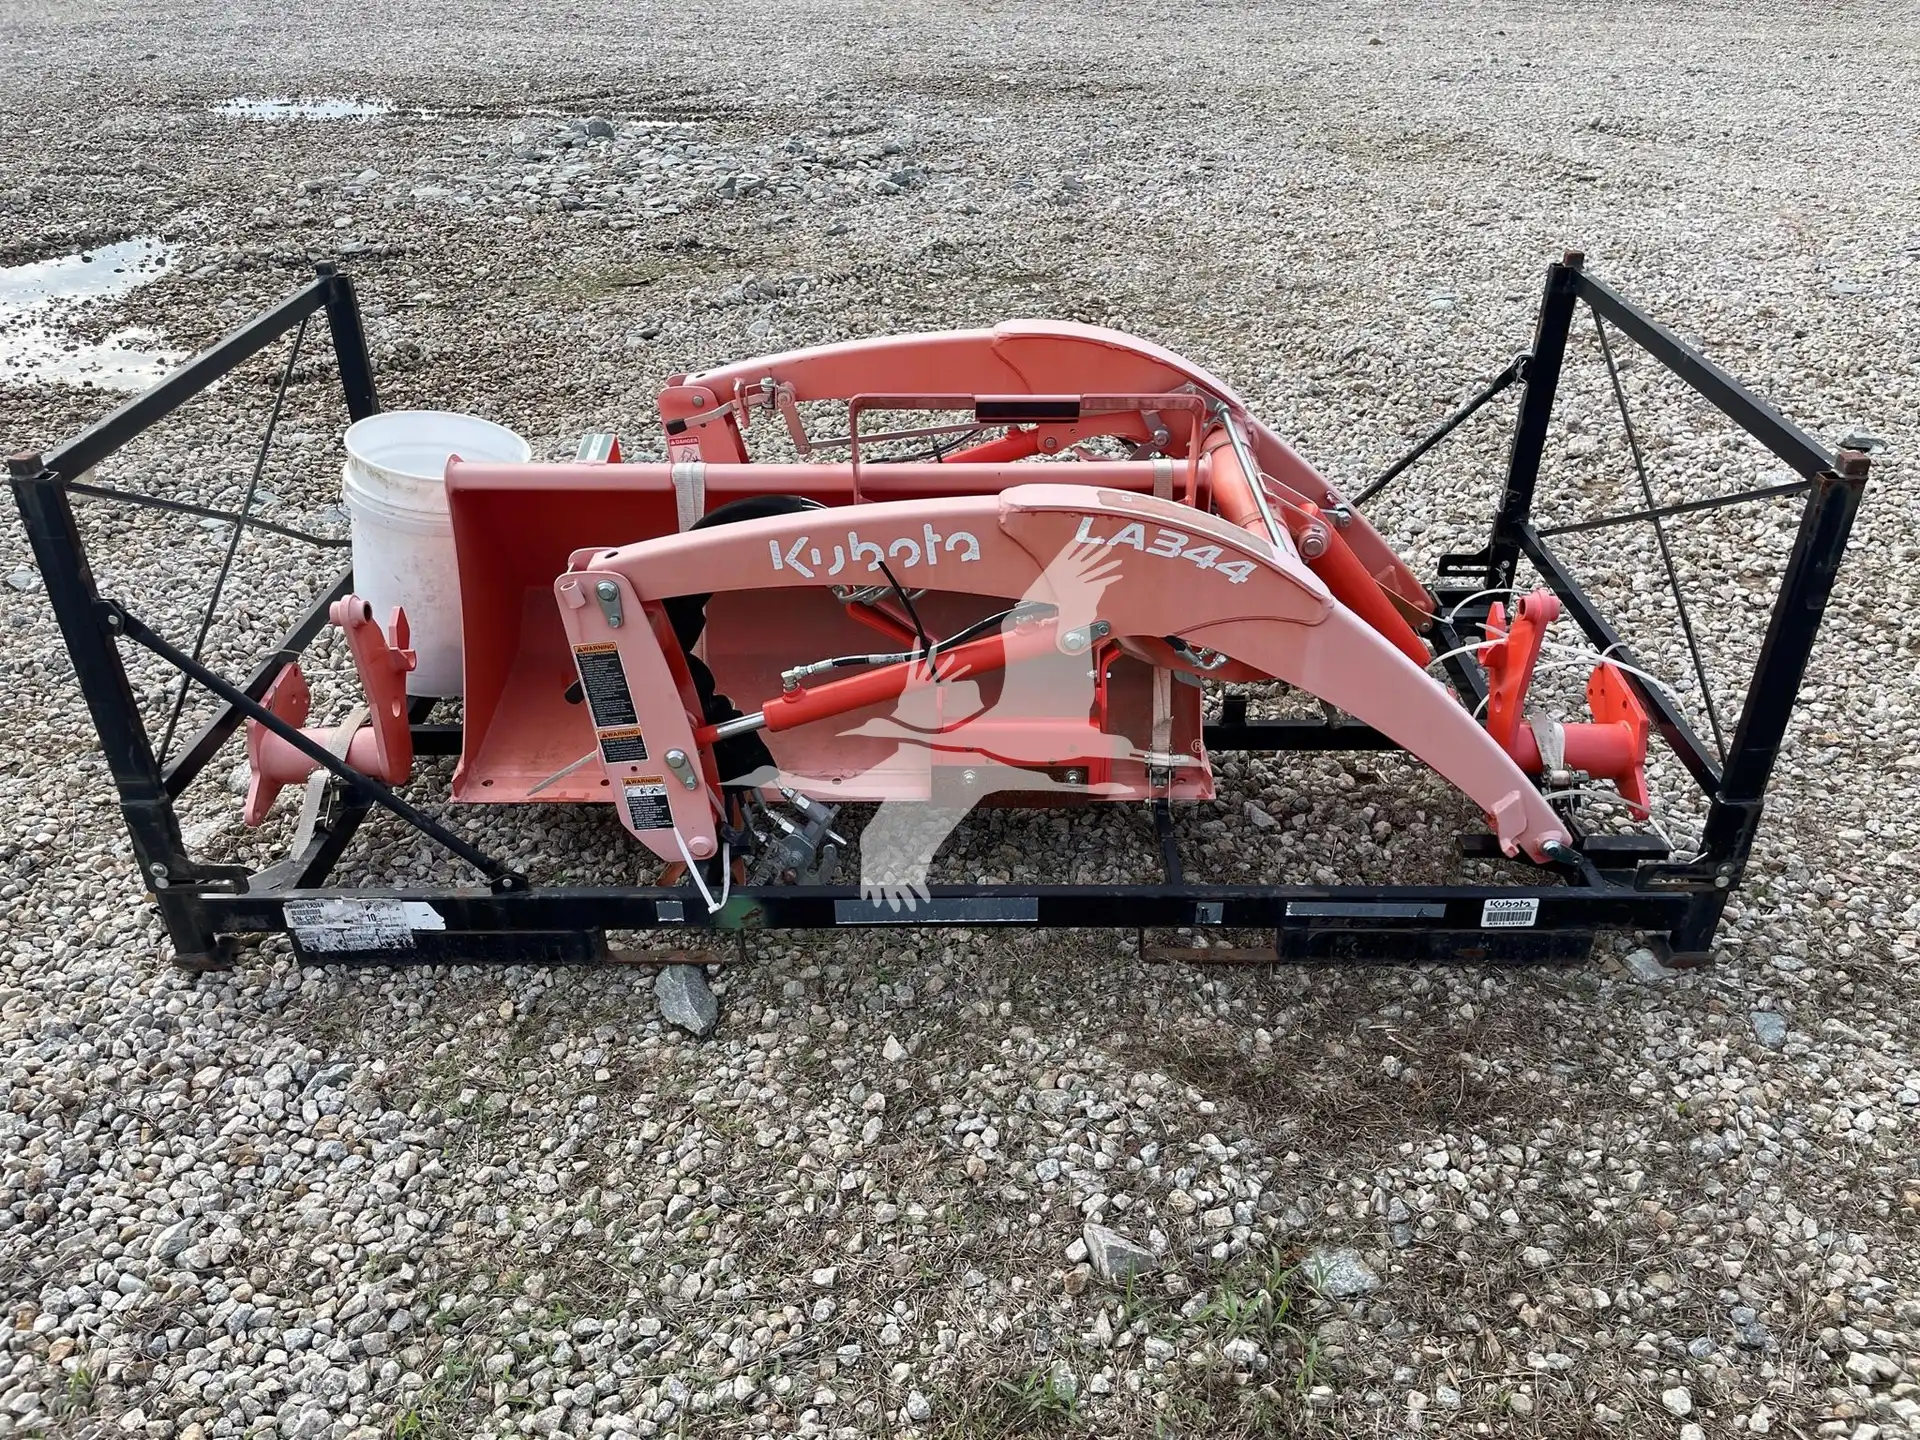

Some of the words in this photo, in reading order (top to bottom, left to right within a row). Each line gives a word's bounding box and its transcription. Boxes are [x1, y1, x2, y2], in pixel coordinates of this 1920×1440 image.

[769, 523, 981, 579] Kubota
[1074, 516, 1257, 584] LA344
[583, 643, 615, 652] WARNING
[607, 729, 639, 738] WARNING
[631, 777, 662, 785] WARNING
[1489, 900, 1531, 909] Kubota
[366, 913, 377, 922] 10
